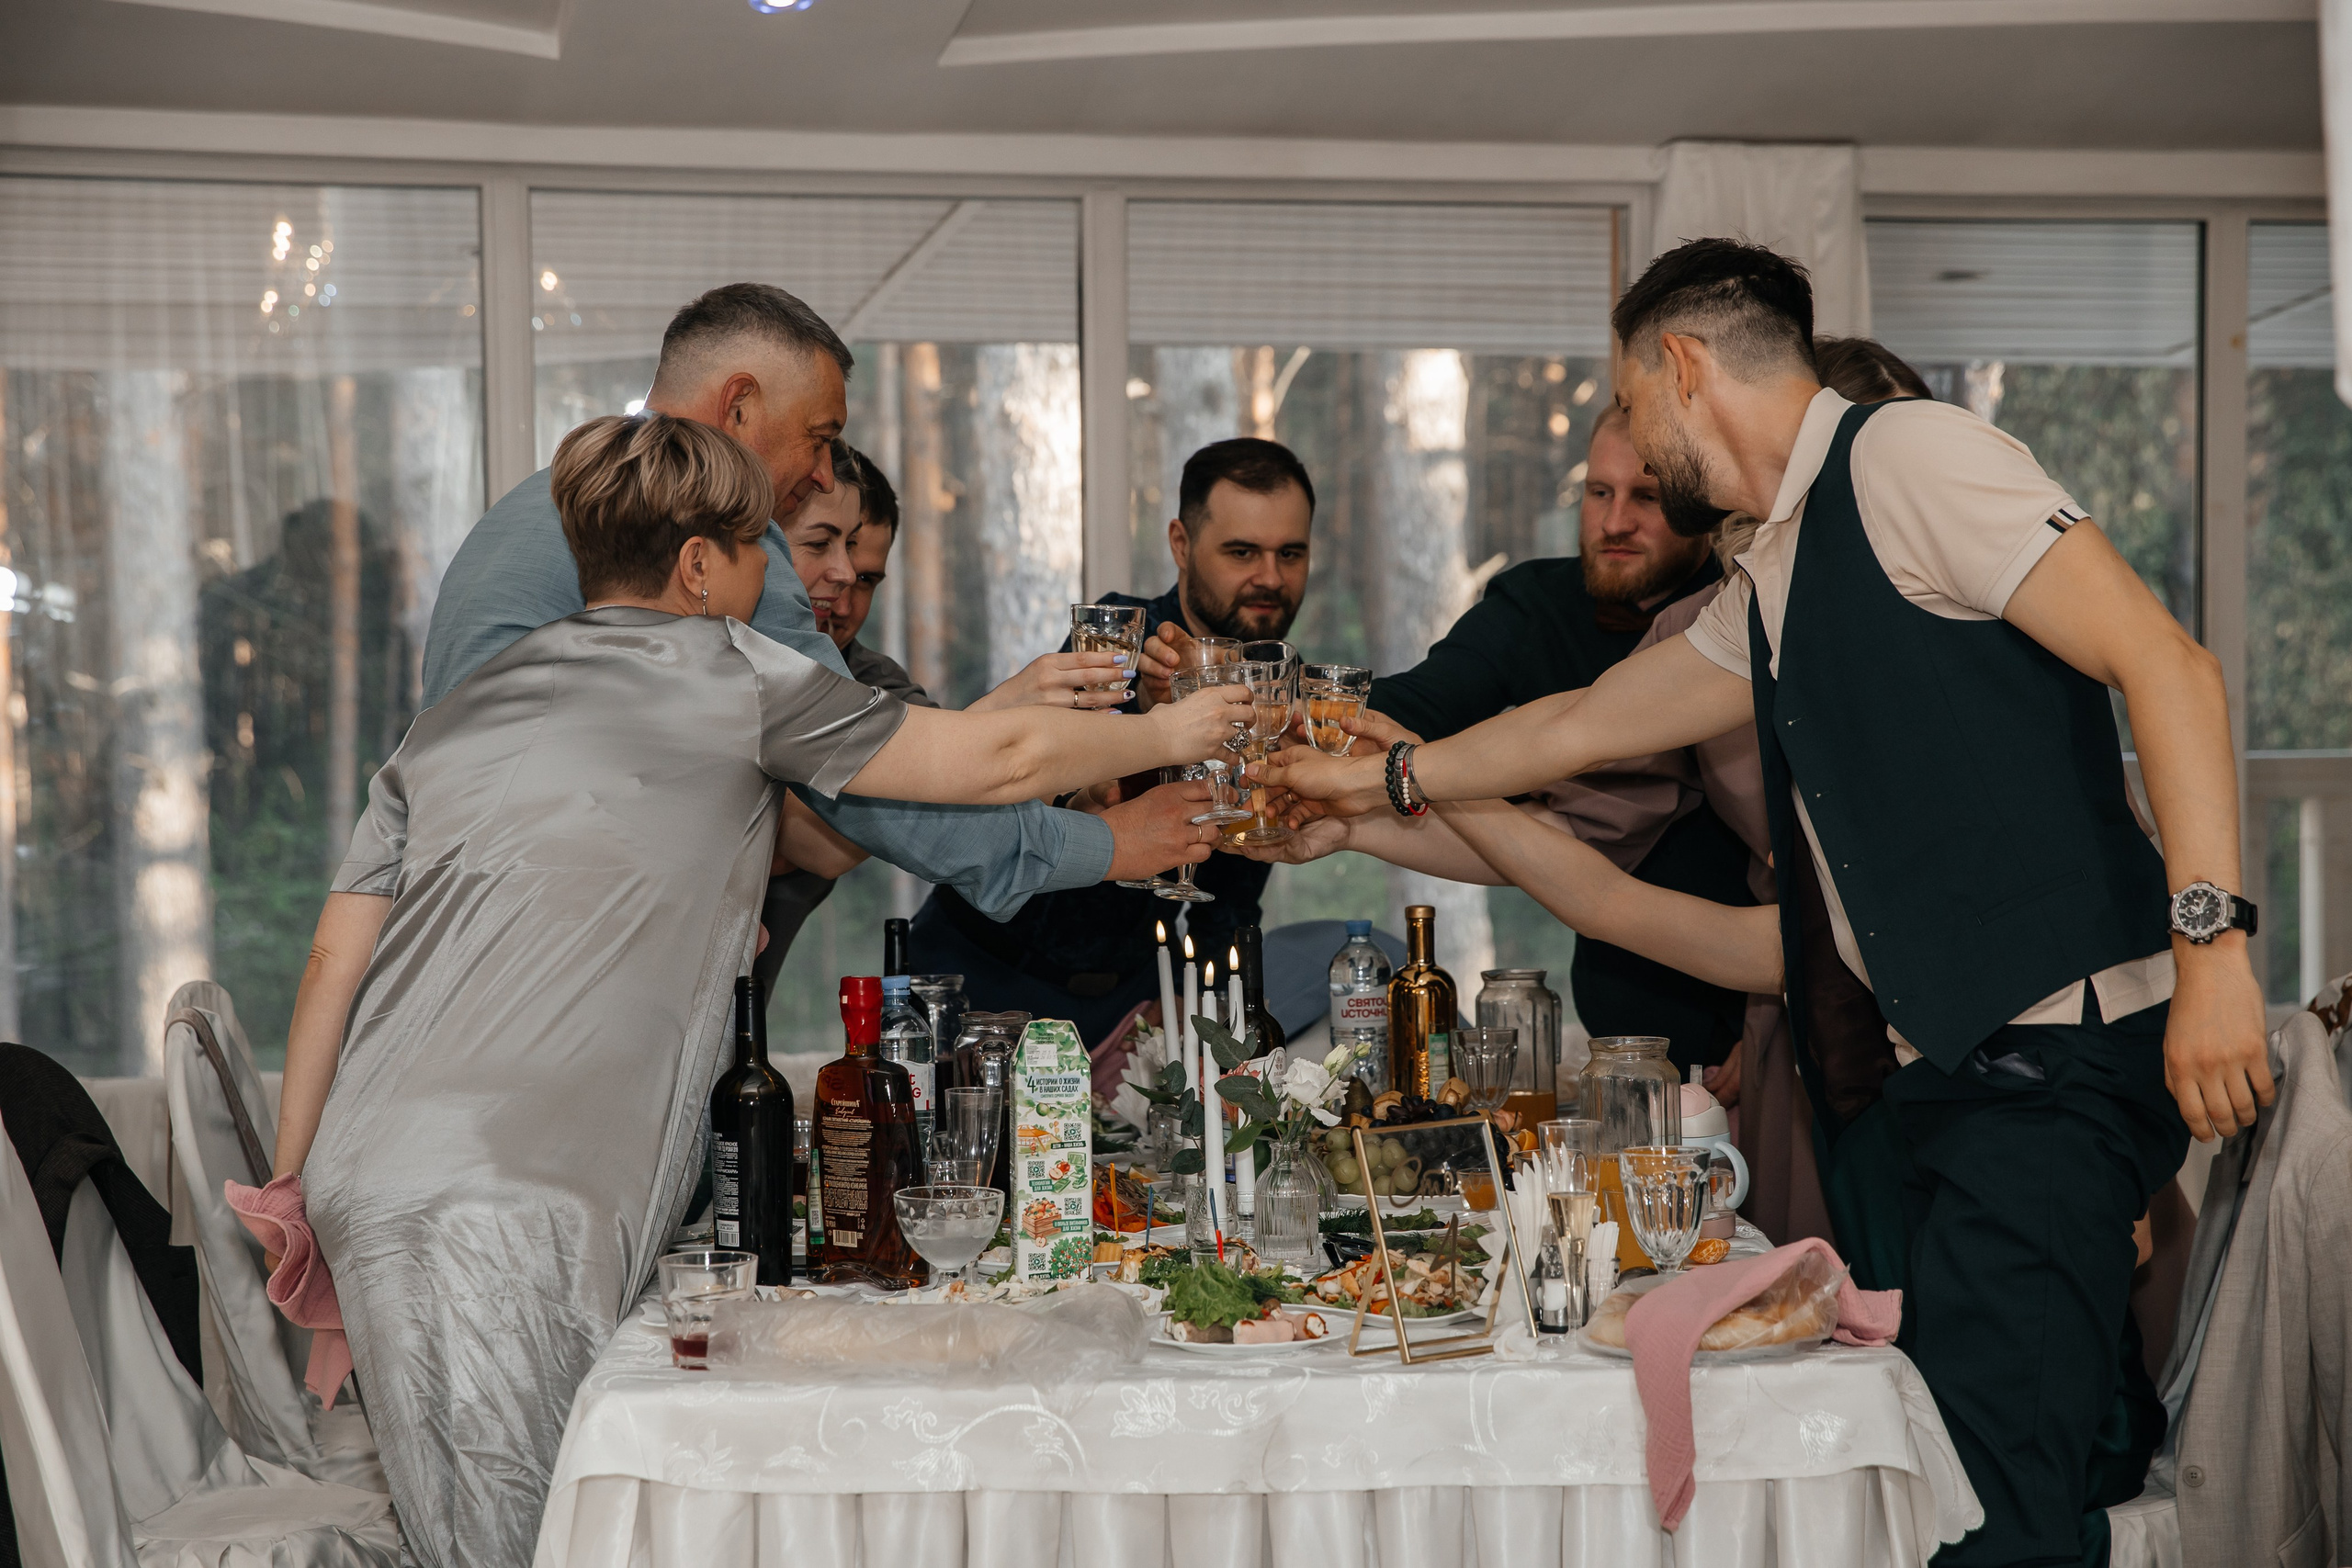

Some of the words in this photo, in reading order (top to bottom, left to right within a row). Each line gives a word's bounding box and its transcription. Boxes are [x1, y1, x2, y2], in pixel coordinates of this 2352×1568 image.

[1341, 1009, 1387, 1018] ИСТОЧНИ
[1027, 1076, 1036, 1093] 4
[1430, 1213, 1466, 1296] 4
